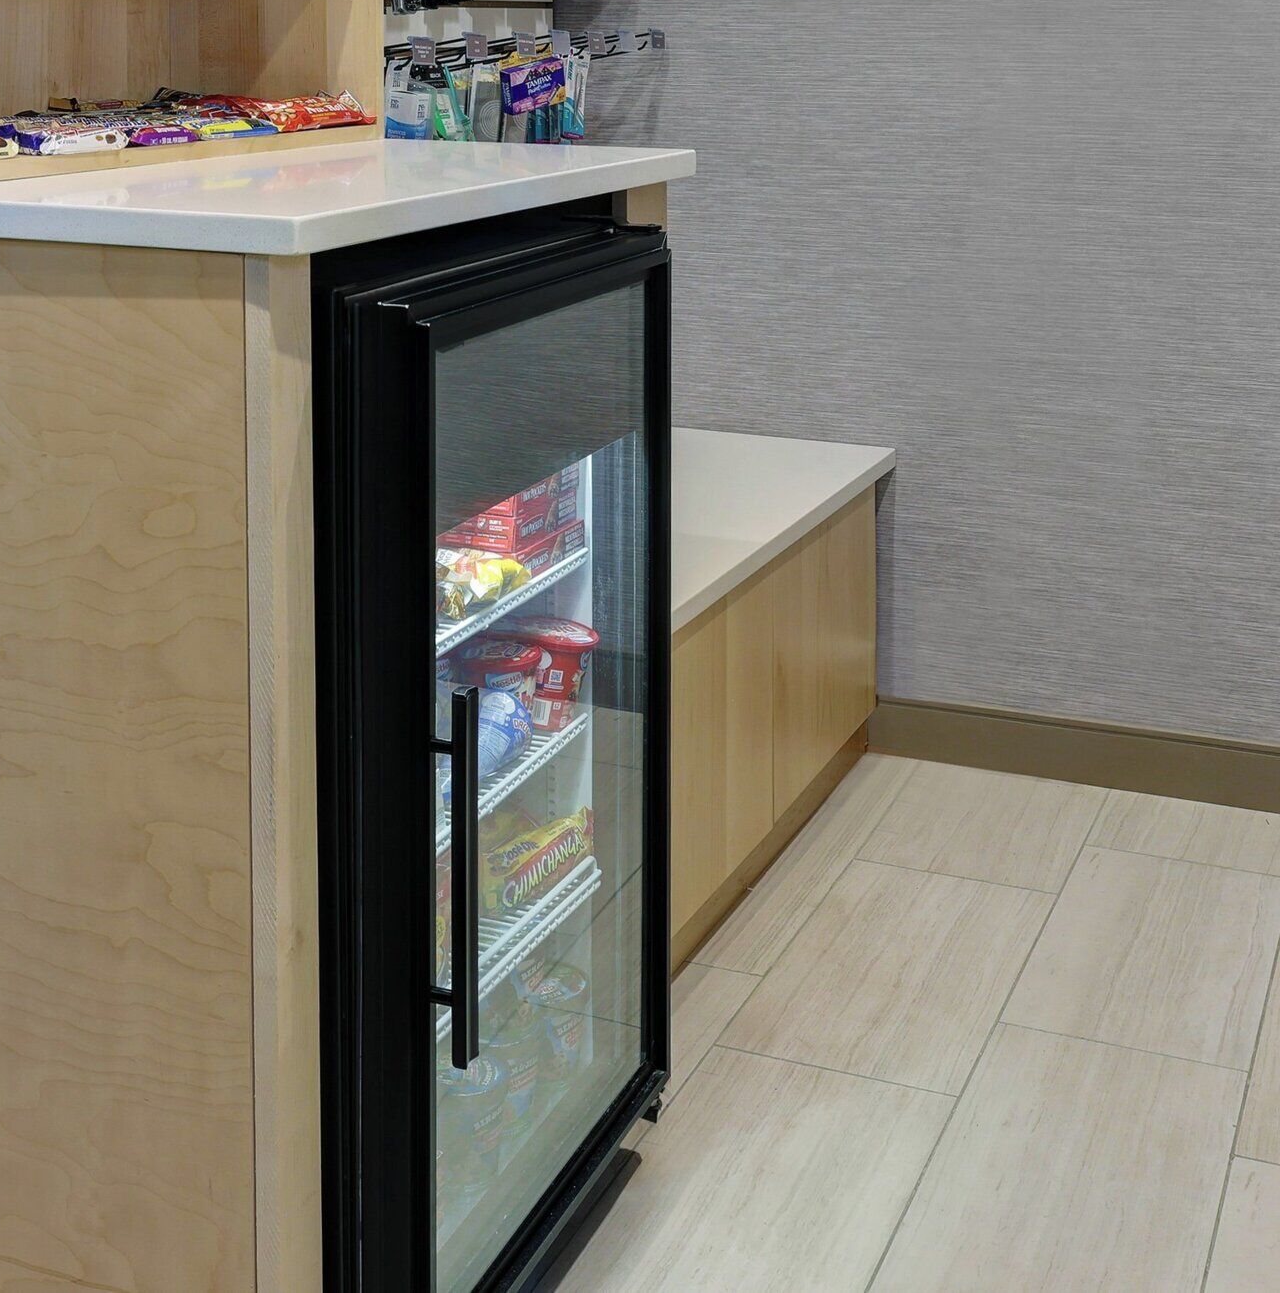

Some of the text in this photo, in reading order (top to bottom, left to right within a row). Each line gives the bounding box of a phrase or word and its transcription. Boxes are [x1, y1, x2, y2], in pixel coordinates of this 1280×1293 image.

[526, 73, 552, 89] TAMPAX
[532, 482, 547, 499] POCKETS
[529, 518, 544, 534] POCKETS
[502, 829, 585, 907] CHIMICHANGA
